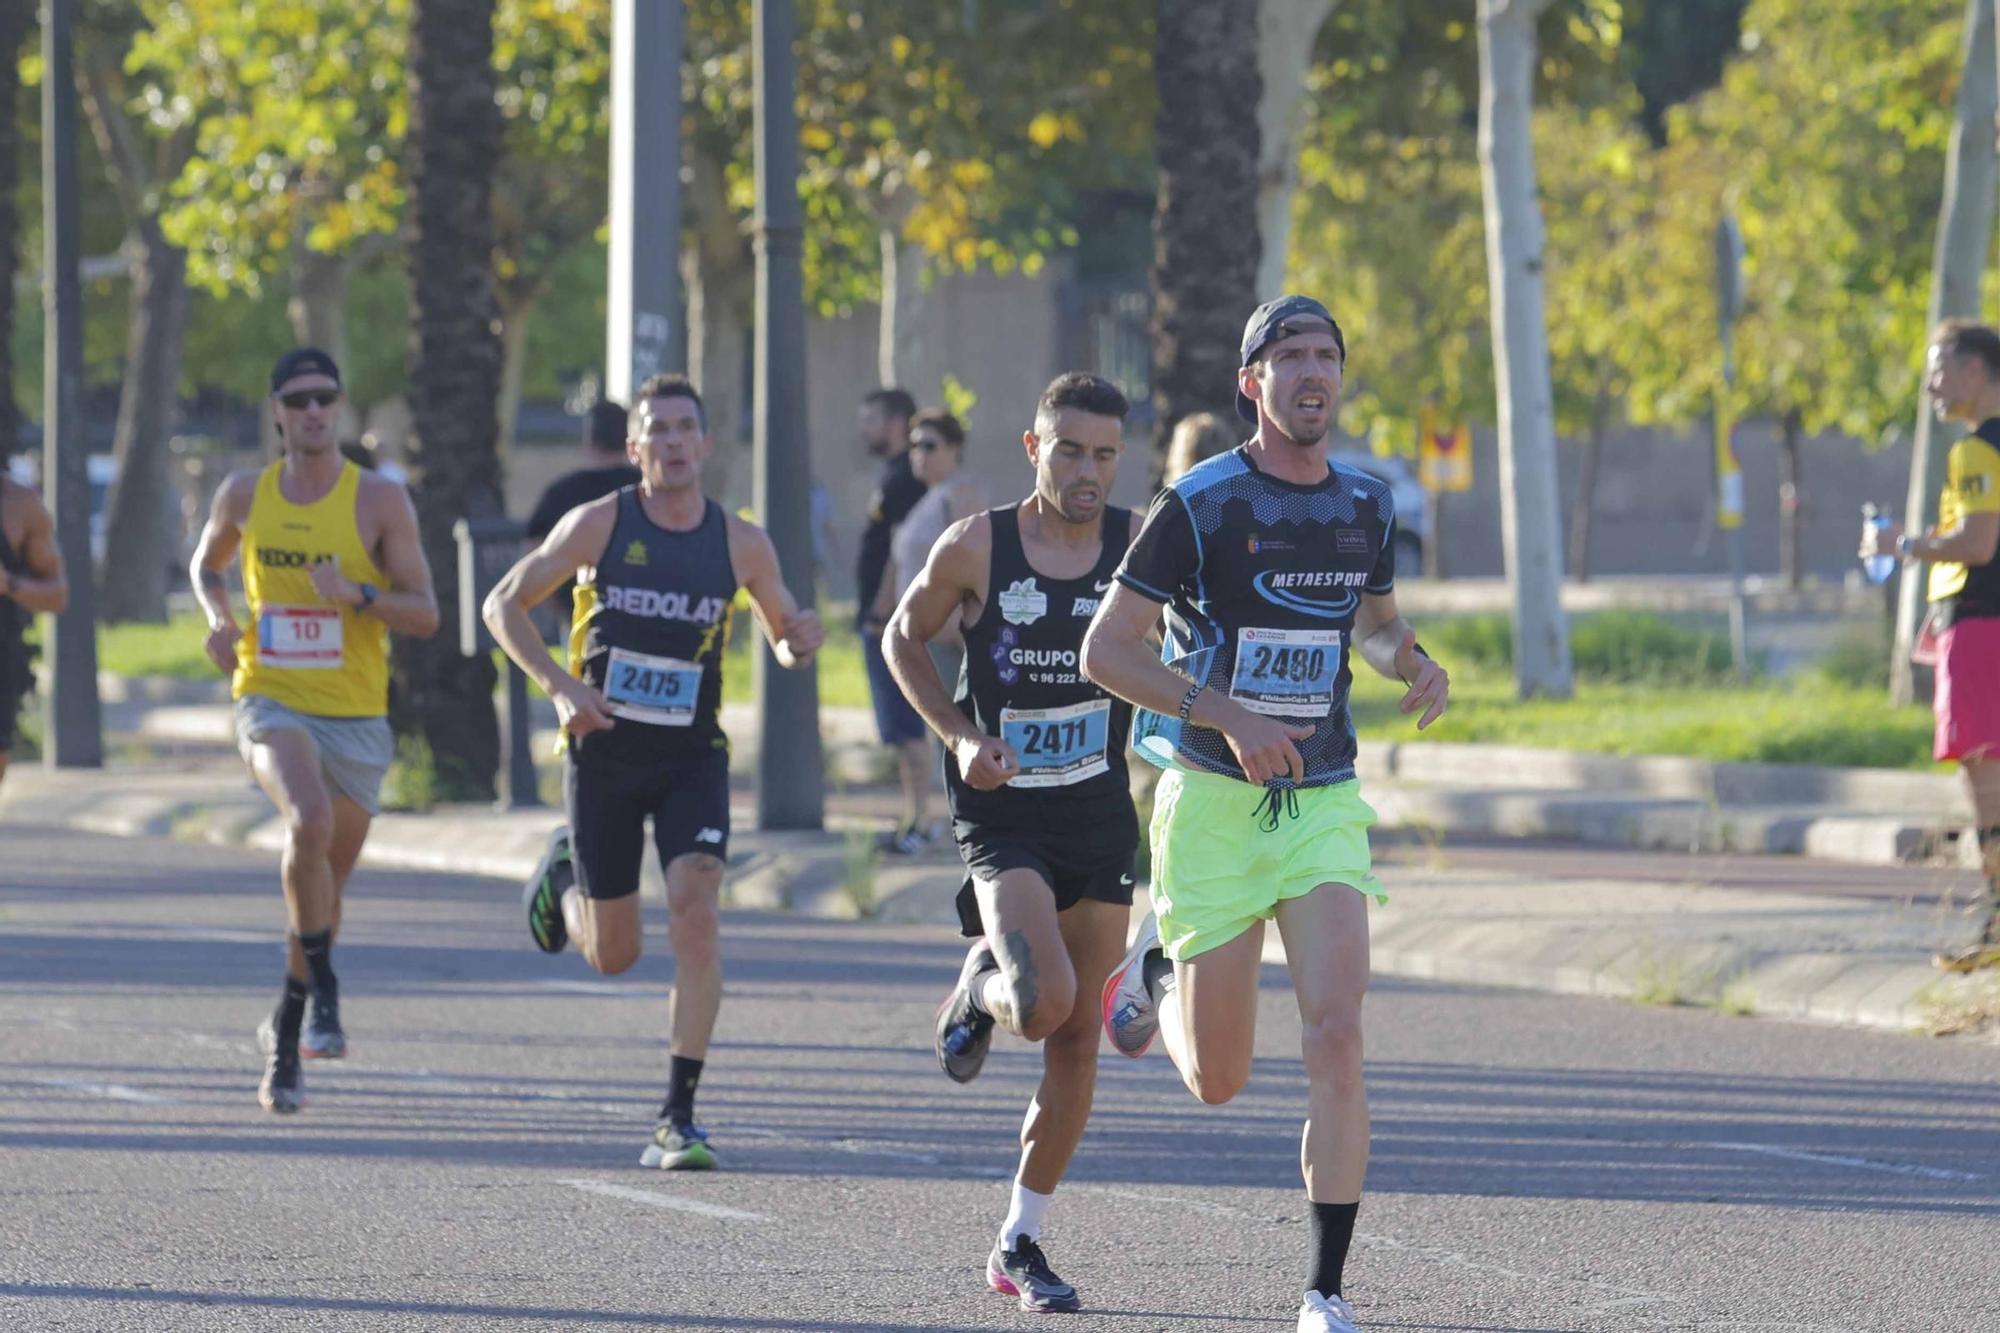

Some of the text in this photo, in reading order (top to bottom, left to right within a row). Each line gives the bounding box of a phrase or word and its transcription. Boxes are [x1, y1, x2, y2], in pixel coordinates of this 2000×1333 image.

[1272, 572, 1368, 588] METAESPORT
[606, 586, 723, 623] REDOLAT
[290, 621, 320, 640] 10
[1009, 648, 1077, 667] GRUPO
[1252, 646, 1324, 682] 2480
[622, 665, 680, 697] 2475
[1040, 673, 1055, 683] 96
[1056, 673, 1077, 684] 222
[1180, 681, 1201, 718] DIEG
[1023, 718, 1086, 754] 2471
